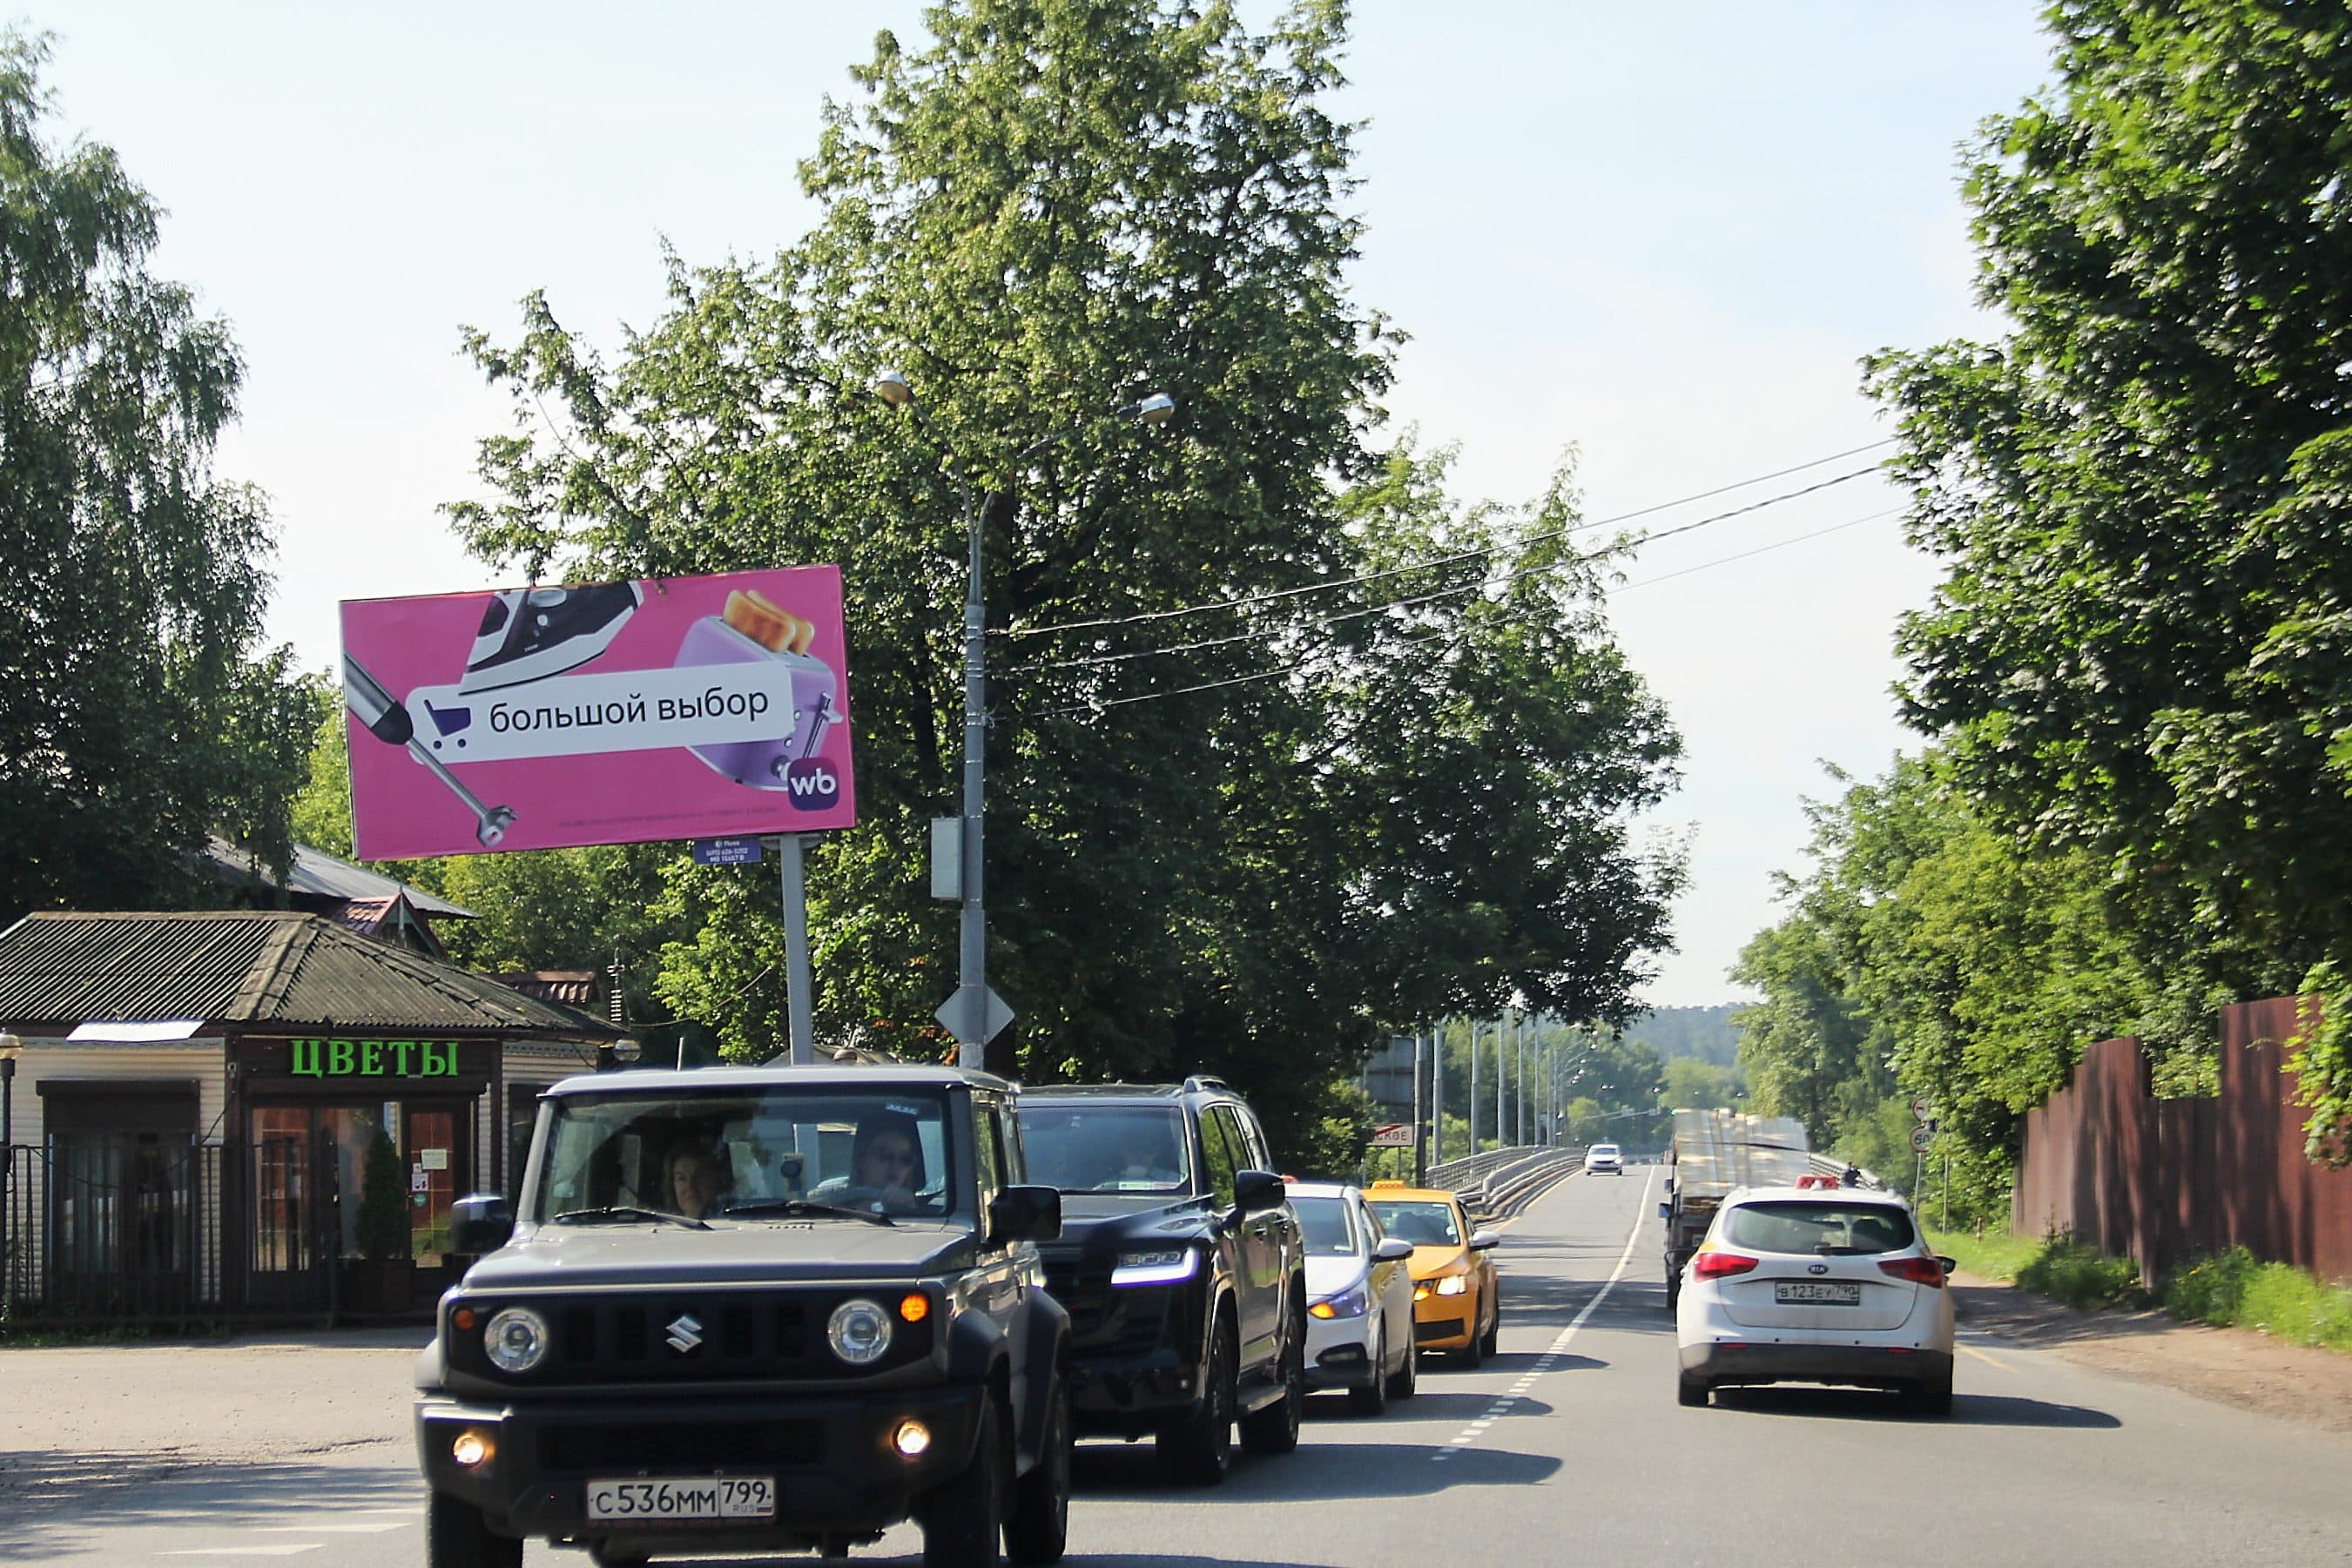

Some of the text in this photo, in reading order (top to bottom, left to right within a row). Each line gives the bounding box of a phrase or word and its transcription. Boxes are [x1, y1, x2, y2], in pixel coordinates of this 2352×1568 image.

[489, 686, 770, 734] большой выбор
[789, 768, 837, 799] wb
[291, 1039, 460, 1080] ЦВЕТЫ
[596, 1480, 767, 1514] С536ММ 799
[732, 1504, 755, 1513] RUS
